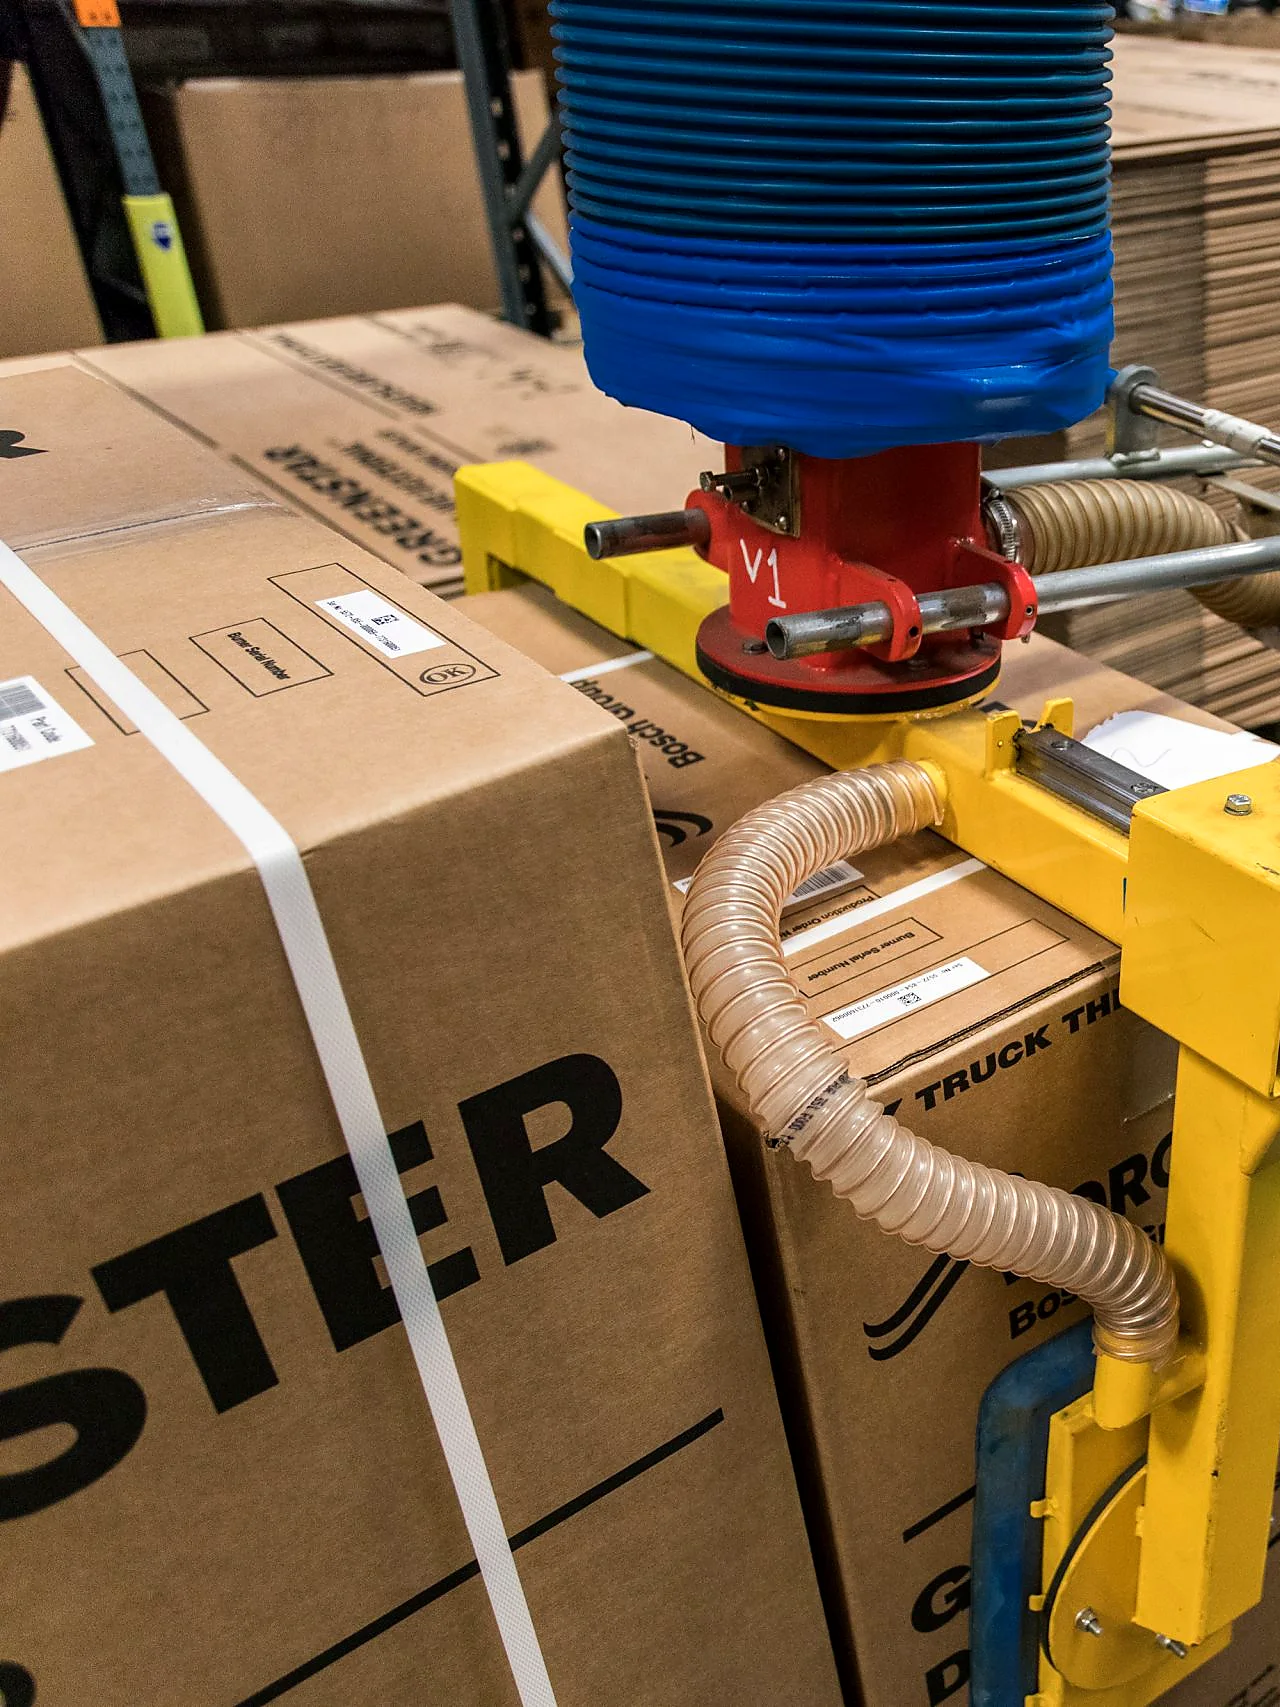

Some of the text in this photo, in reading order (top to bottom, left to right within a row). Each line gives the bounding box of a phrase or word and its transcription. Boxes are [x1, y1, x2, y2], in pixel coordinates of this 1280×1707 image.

[740, 538, 787, 609] V1
[627, 719, 706, 769] Bosch
[791, 917, 822, 933] Order
[807, 931, 916, 981] Burner Serial Number
[915, 1024, 1053, 1112] TRUCK
